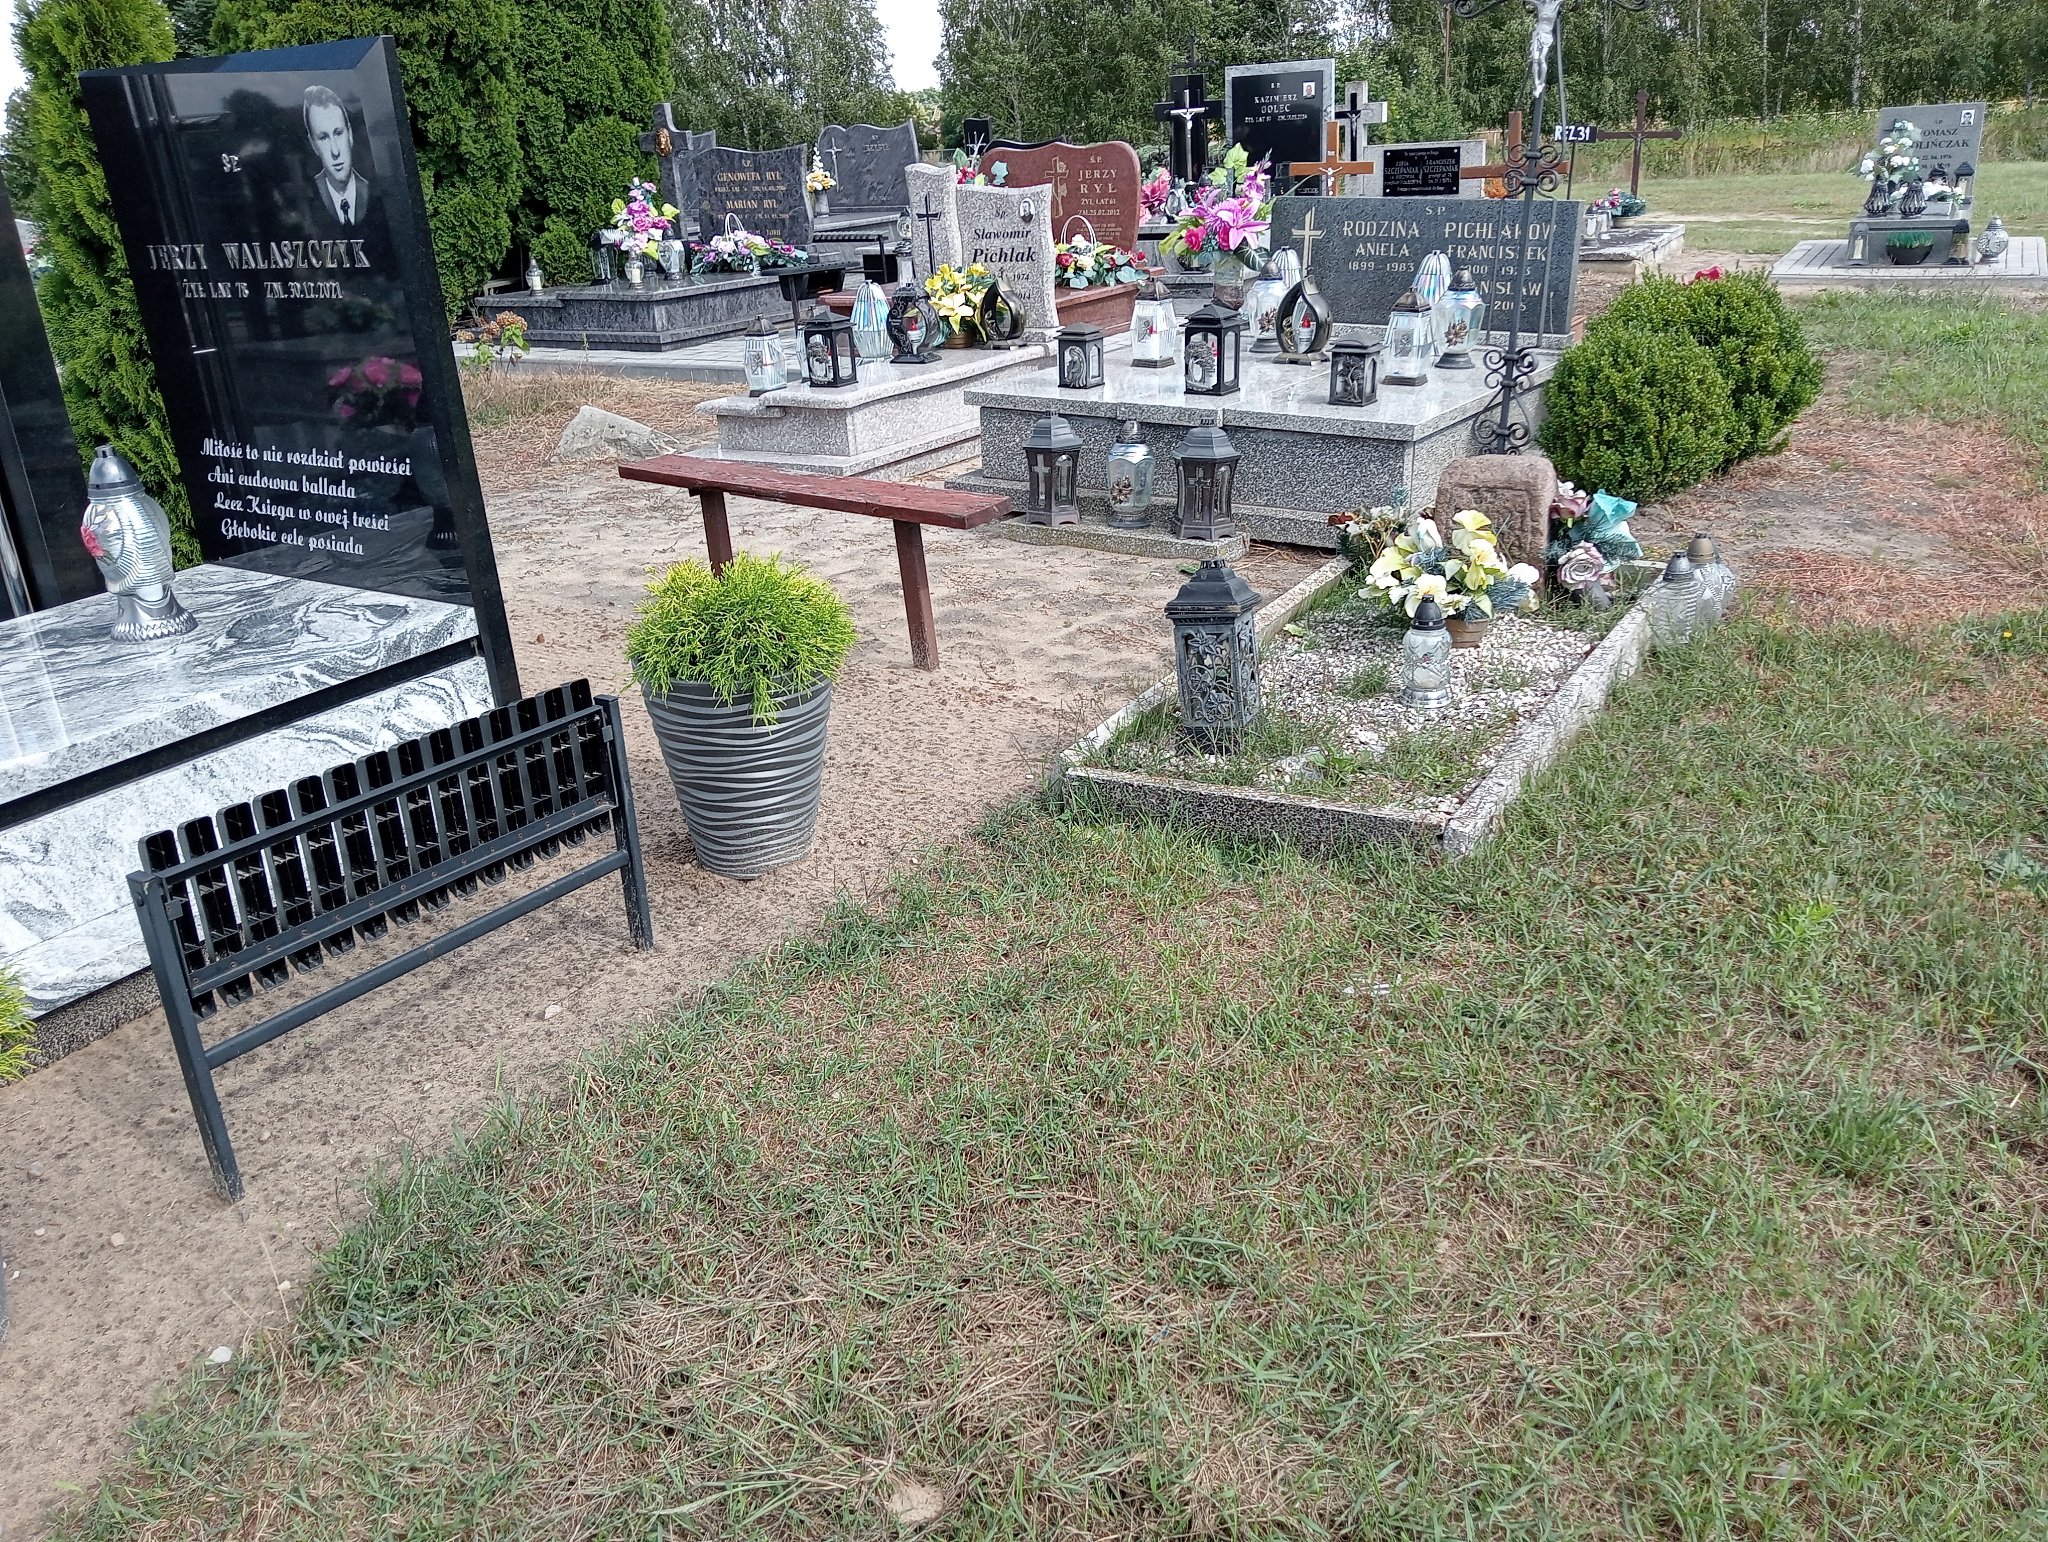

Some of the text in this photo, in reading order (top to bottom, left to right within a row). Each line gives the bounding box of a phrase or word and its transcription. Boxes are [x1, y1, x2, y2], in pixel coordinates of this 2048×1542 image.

[1254, 94, 1298, 104] KAZIMERZ
[1920, 128, 1958, 137] OMASZ
[1910, 138, 1970, 150] OLIŃCZAK
[717, 171, 761, 182] GENOWEFA
[1078, 169, 1118, 182] JERZY
[726, 200, 758, 209] MARIAN
[974, 226, 1032, 240] Sławomir
[1342, 220, 1420, 239] RODZINA
[147, 243, 209, 270] JERZY
[222, 239, 371, 270] WALASZCZYK
[971, 246, 1037, 263] Pichlak
[1354, 242, 1548, 261] ANIELA FRANCISEK
[1348, 260, 1376, 271] 1899
[1386, 262, 1415, 272] 1983
[200, 437, 413, 476] Miłość to nie rozdział powieści
[207, 465, 357, 499] Ani cudowna ballada
[213, 491, 391, 532] Lecz Księga w owej treści
[220, 518, 365, 556] Głębokie cele posiada
